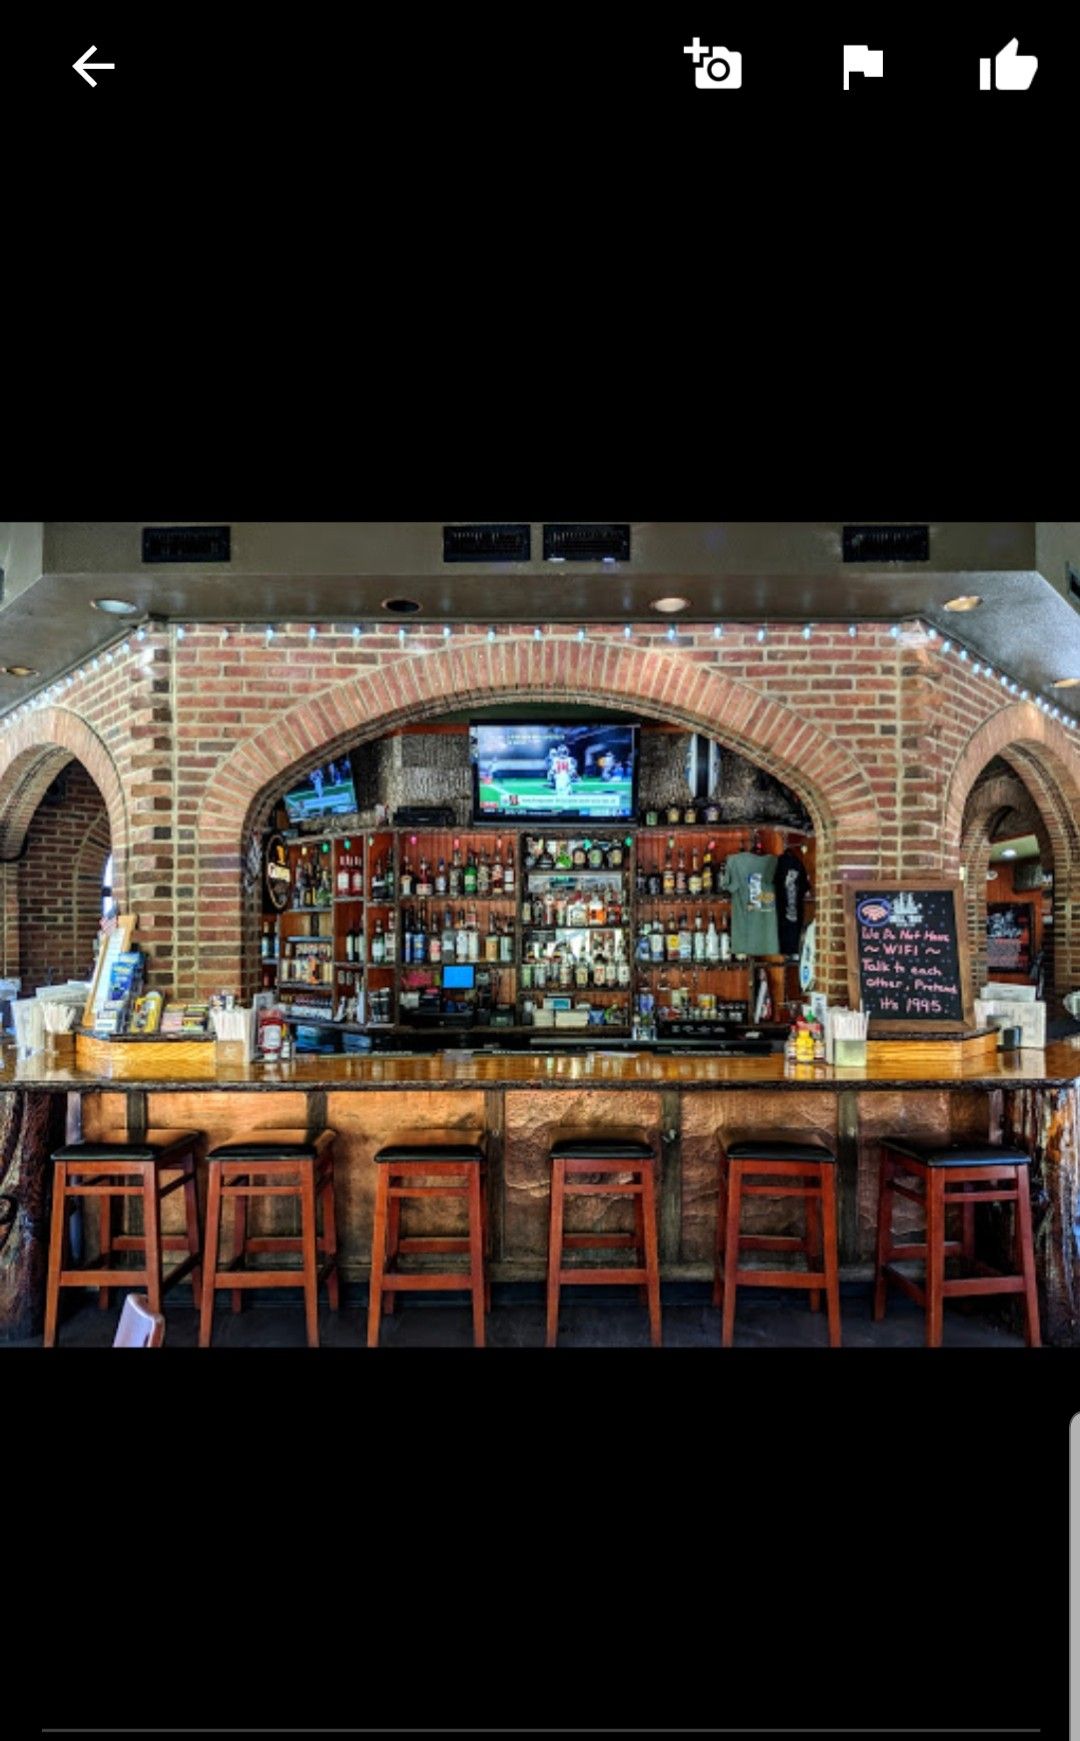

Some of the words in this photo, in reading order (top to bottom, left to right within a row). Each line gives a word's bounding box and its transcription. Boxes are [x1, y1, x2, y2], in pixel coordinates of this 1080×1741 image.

[862, 927, 879, 940] We
[900, 930, 922, 940] Not
[923, 930, 950, 942] Have
[883, 943, 918, 955] WIFI
[862, 958, 890, 972] Talk
[894, 961, 905, 973] to
[911, 966, 943, 976] each
[914, 979, 958, 995] Pretend
[880, 996, 899, 1011] It's
